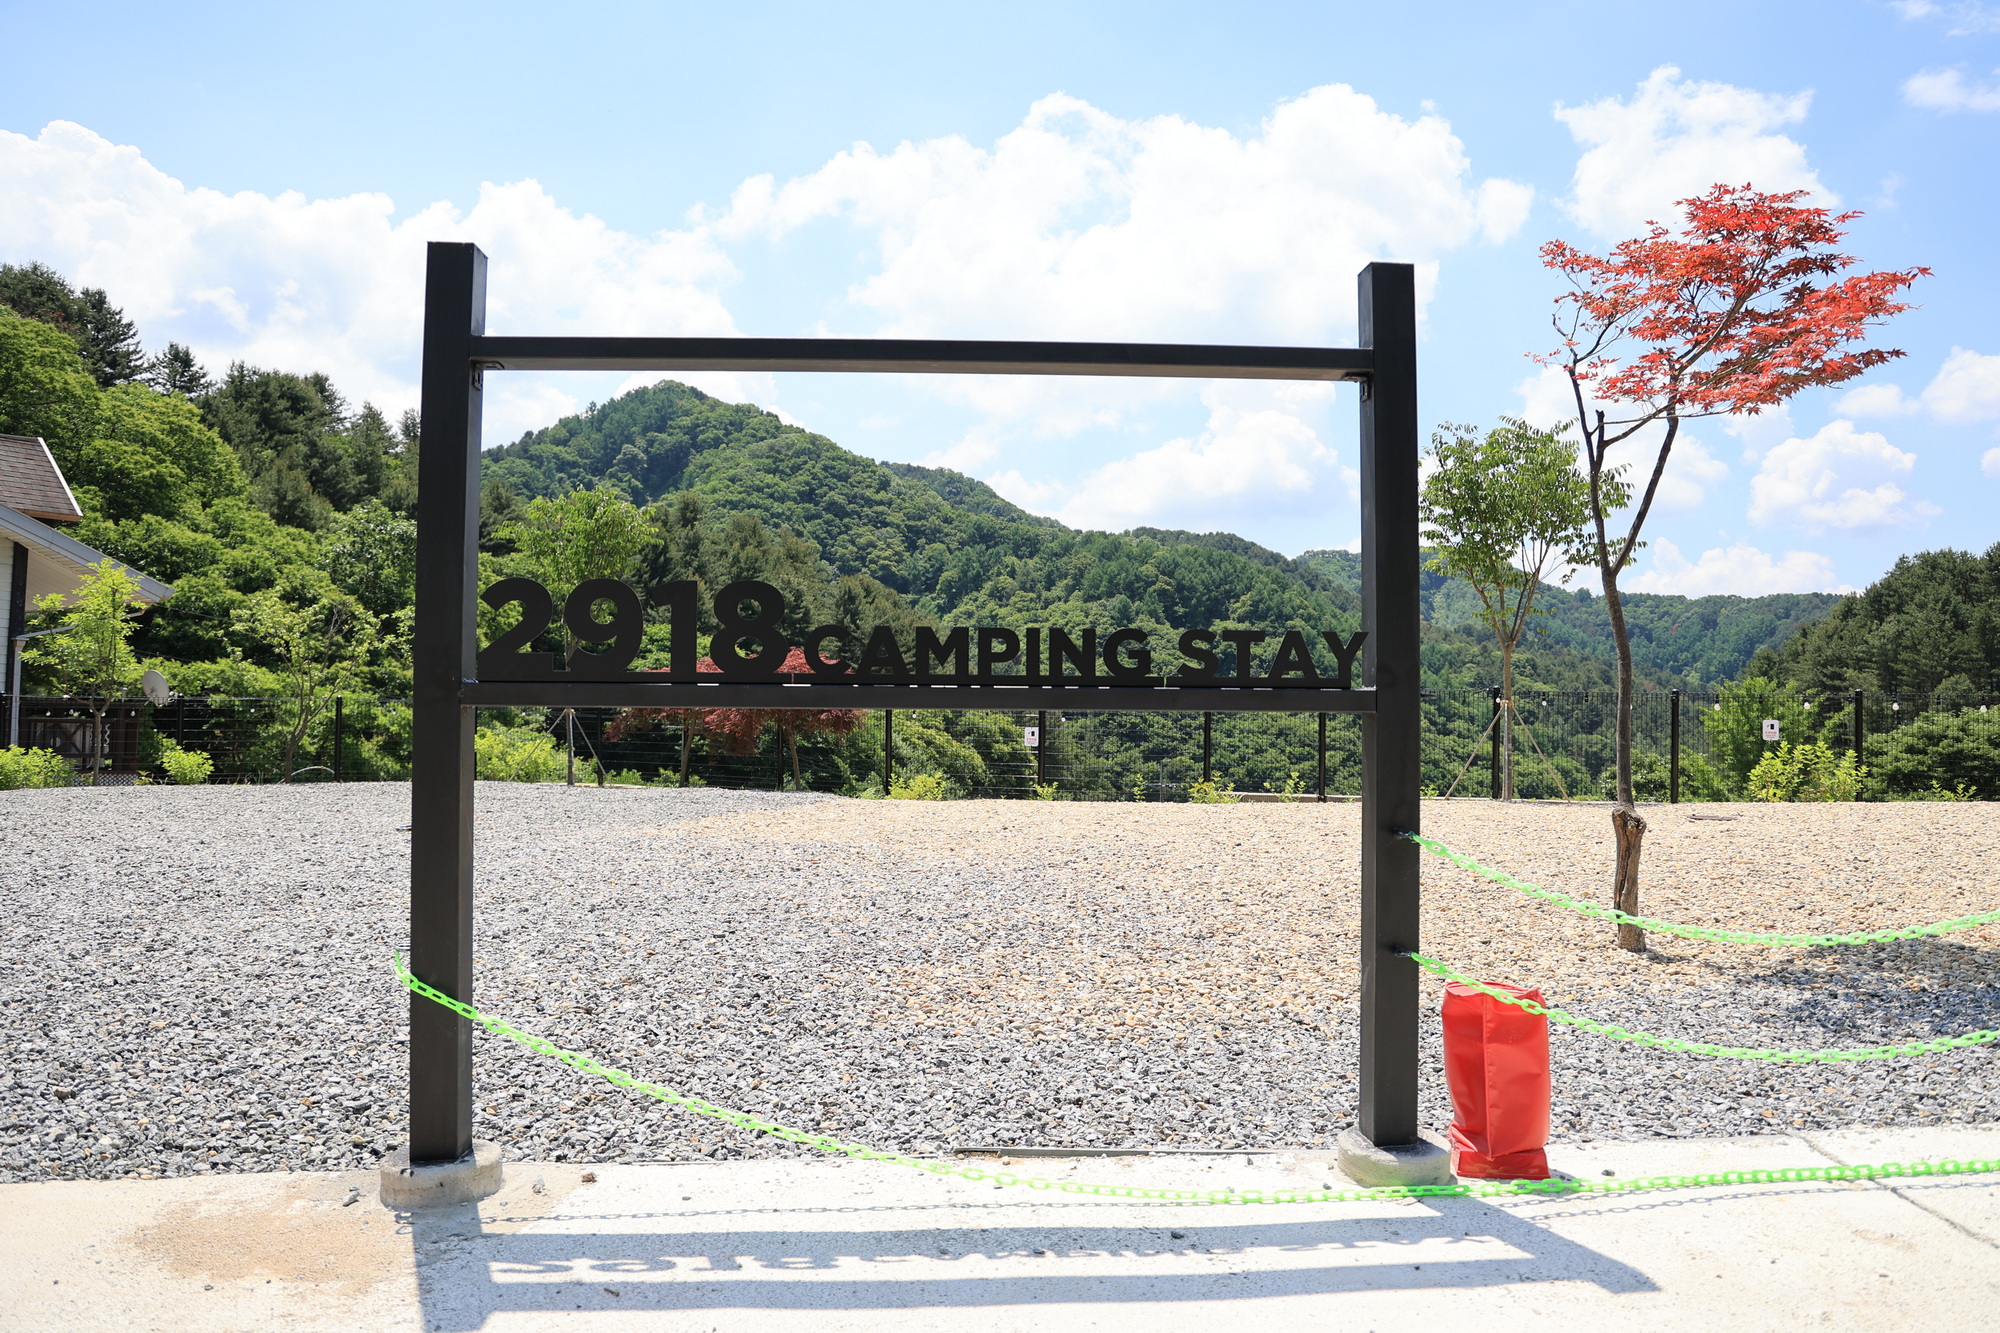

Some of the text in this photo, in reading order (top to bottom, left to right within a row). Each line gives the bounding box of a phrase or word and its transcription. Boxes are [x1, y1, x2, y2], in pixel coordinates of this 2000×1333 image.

[476, 577, 1370, 683] 2918 CAMPING STAY
